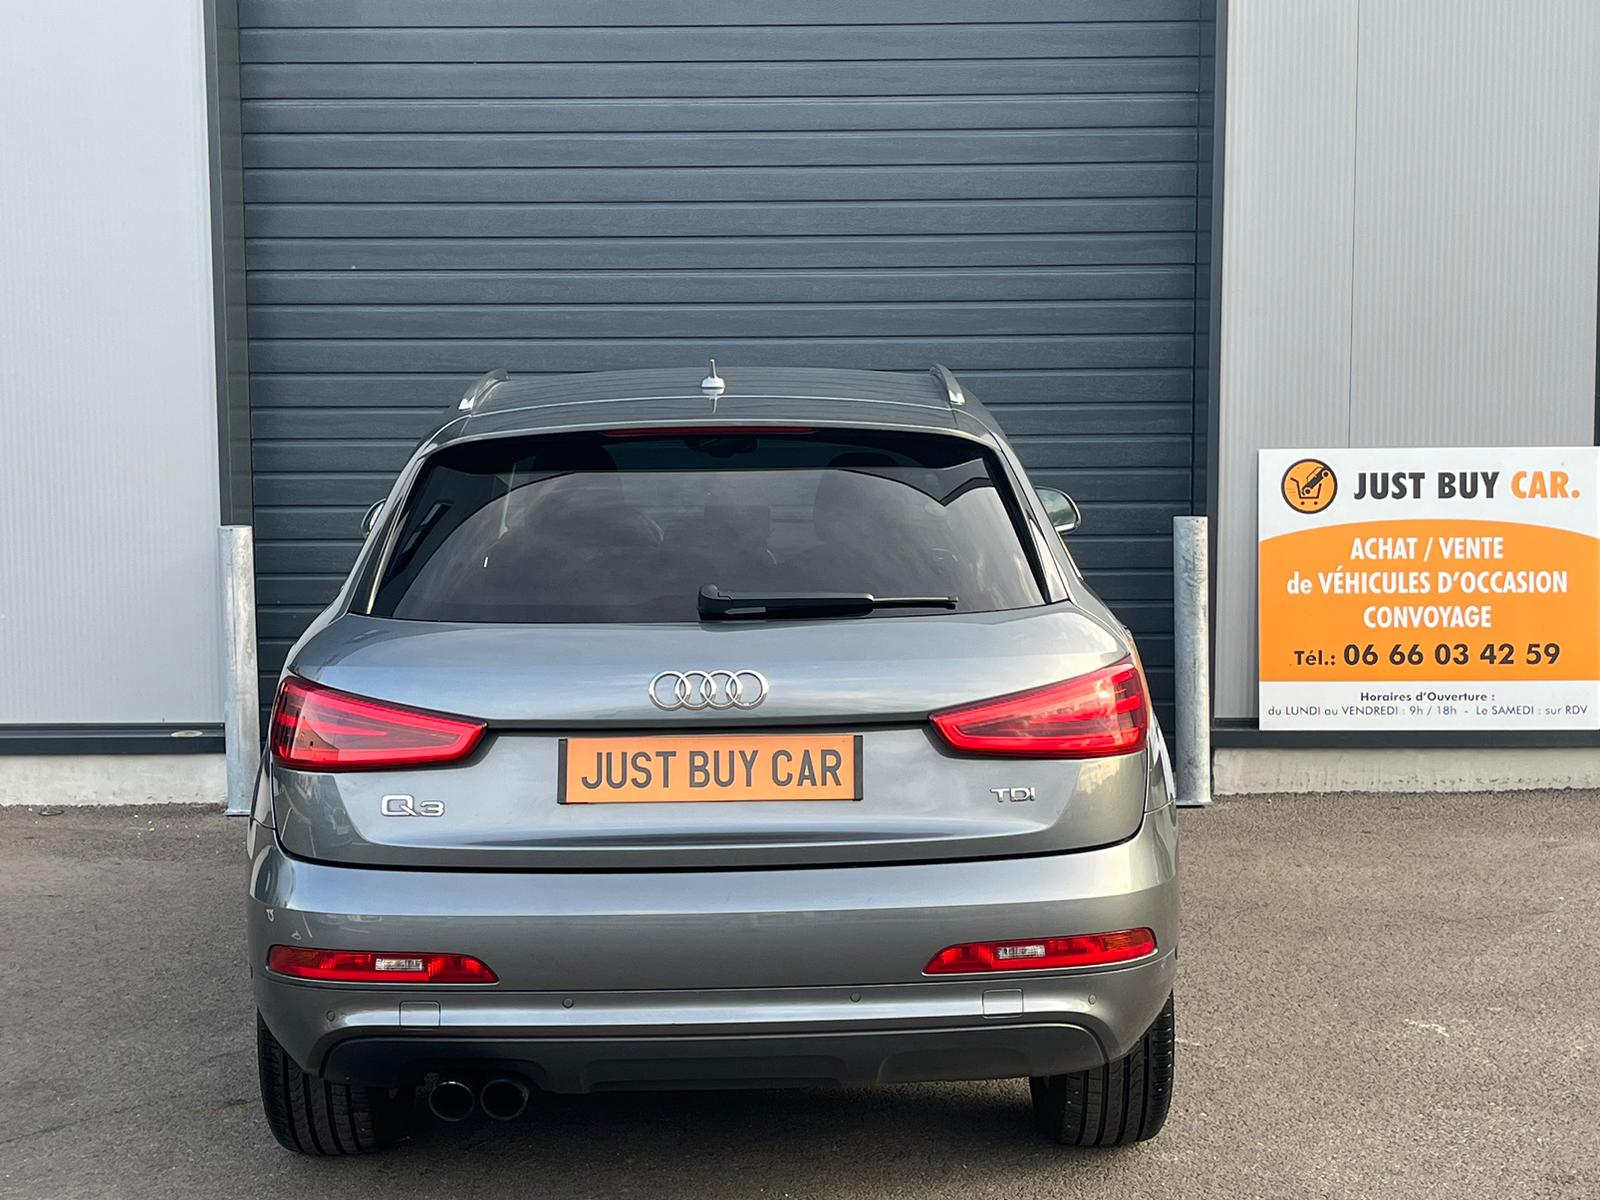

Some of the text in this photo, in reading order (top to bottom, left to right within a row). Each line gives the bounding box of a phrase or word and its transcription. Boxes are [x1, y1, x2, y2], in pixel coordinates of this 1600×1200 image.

[1353, 471, 1581, 500] JUST BUY CAR.
[1350, 537, 1418, 561] ACHAT
[1438, 537, 1504, 560] VENTE
[1286, 565, 1568, 595] de VÉHICULES D'OCCASION
[1363, 605, 1492, 629] CONVOYAGE
[1294, 642, 1561, 666] Tél.: 06 66 03 42 59
[1360, 691, 1412, 702] Horaires
[1415, 691, 1488, 702] d'Ouverture
[1268, 705, 1282, 716] du
[1285, 705, 1321, 716] LUNDI
[1324, 706, 1338, 716] au
[1341, 705, 1399, 716] VENDREDI
[1409, 705, 1424, 716] 9h
[1437, 705, 1457, 716] 18h
[1476, 705, 1488, 716] Le
[1491, 705, 1534, 716] SAMEDI
[1545, 707, 1562, 716] sur
[1565, 704, 1588, 716] RDV
[581, 748, 843, 789] JUST BUY CAR
[381, 794, 445, 817] Q3
[989, 786, 1036, 803] TDI
